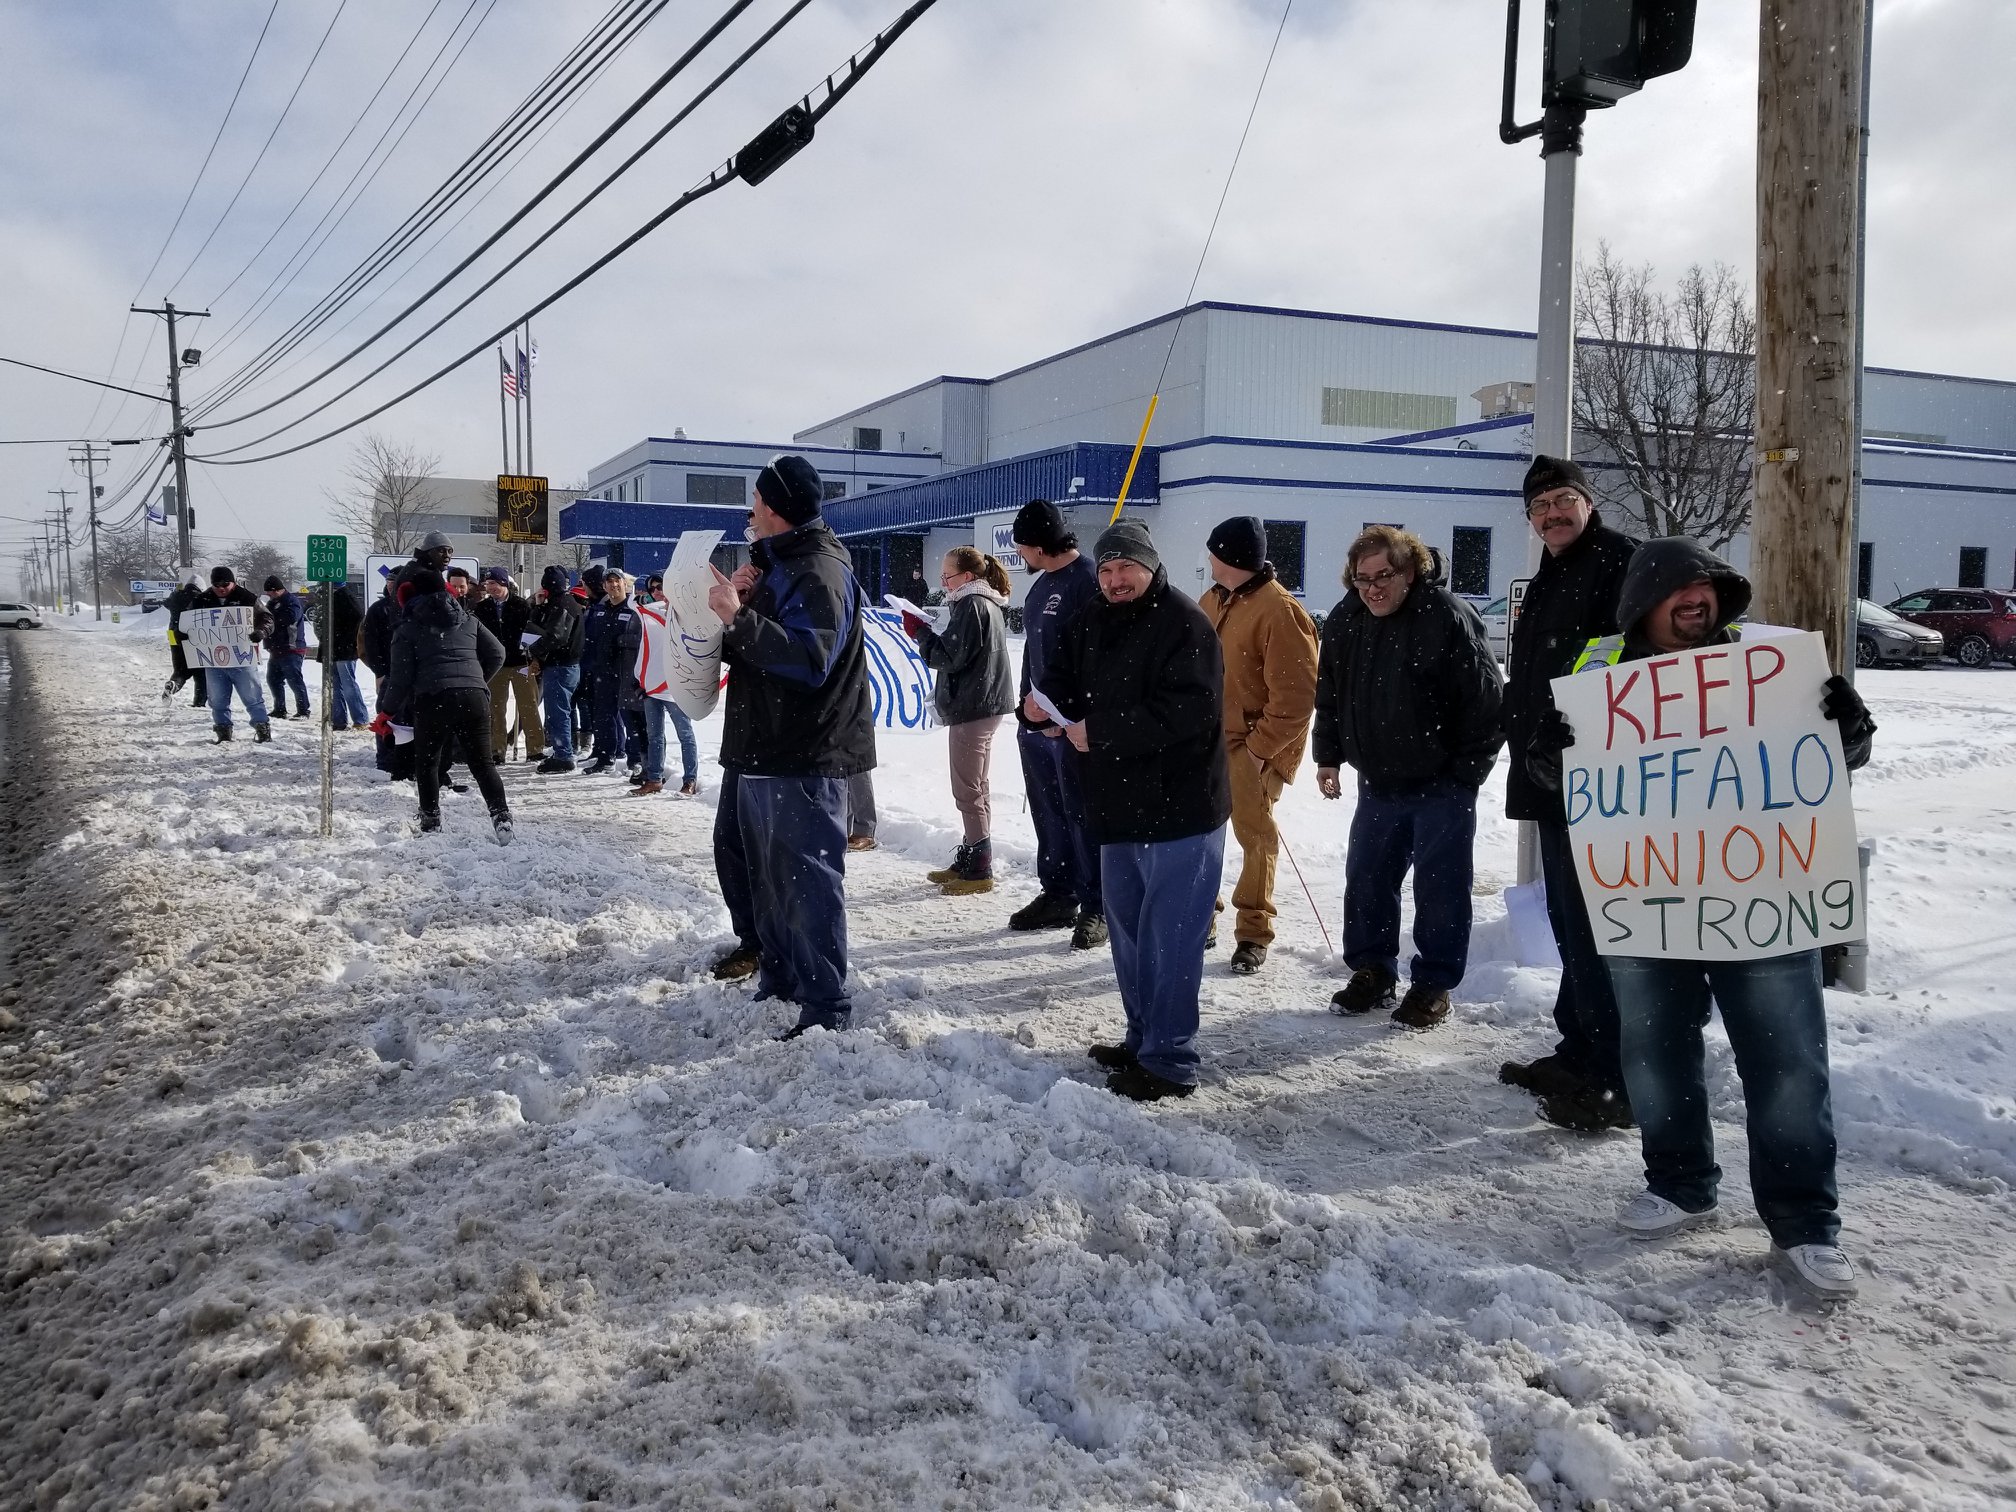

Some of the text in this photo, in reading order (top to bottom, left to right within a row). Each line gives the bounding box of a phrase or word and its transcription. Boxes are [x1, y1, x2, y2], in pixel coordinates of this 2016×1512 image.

[499, 476, 547, 491] SOLIDARITY!
[192, 607, 253, 627] #FAIR
[196, 645, 261, 666] NOW!
[1606, 645, 1785, 750] KEEP
[1568, 733, 1834, 826] BUFFALO
[1588, 816, 1816, 889] UNION
